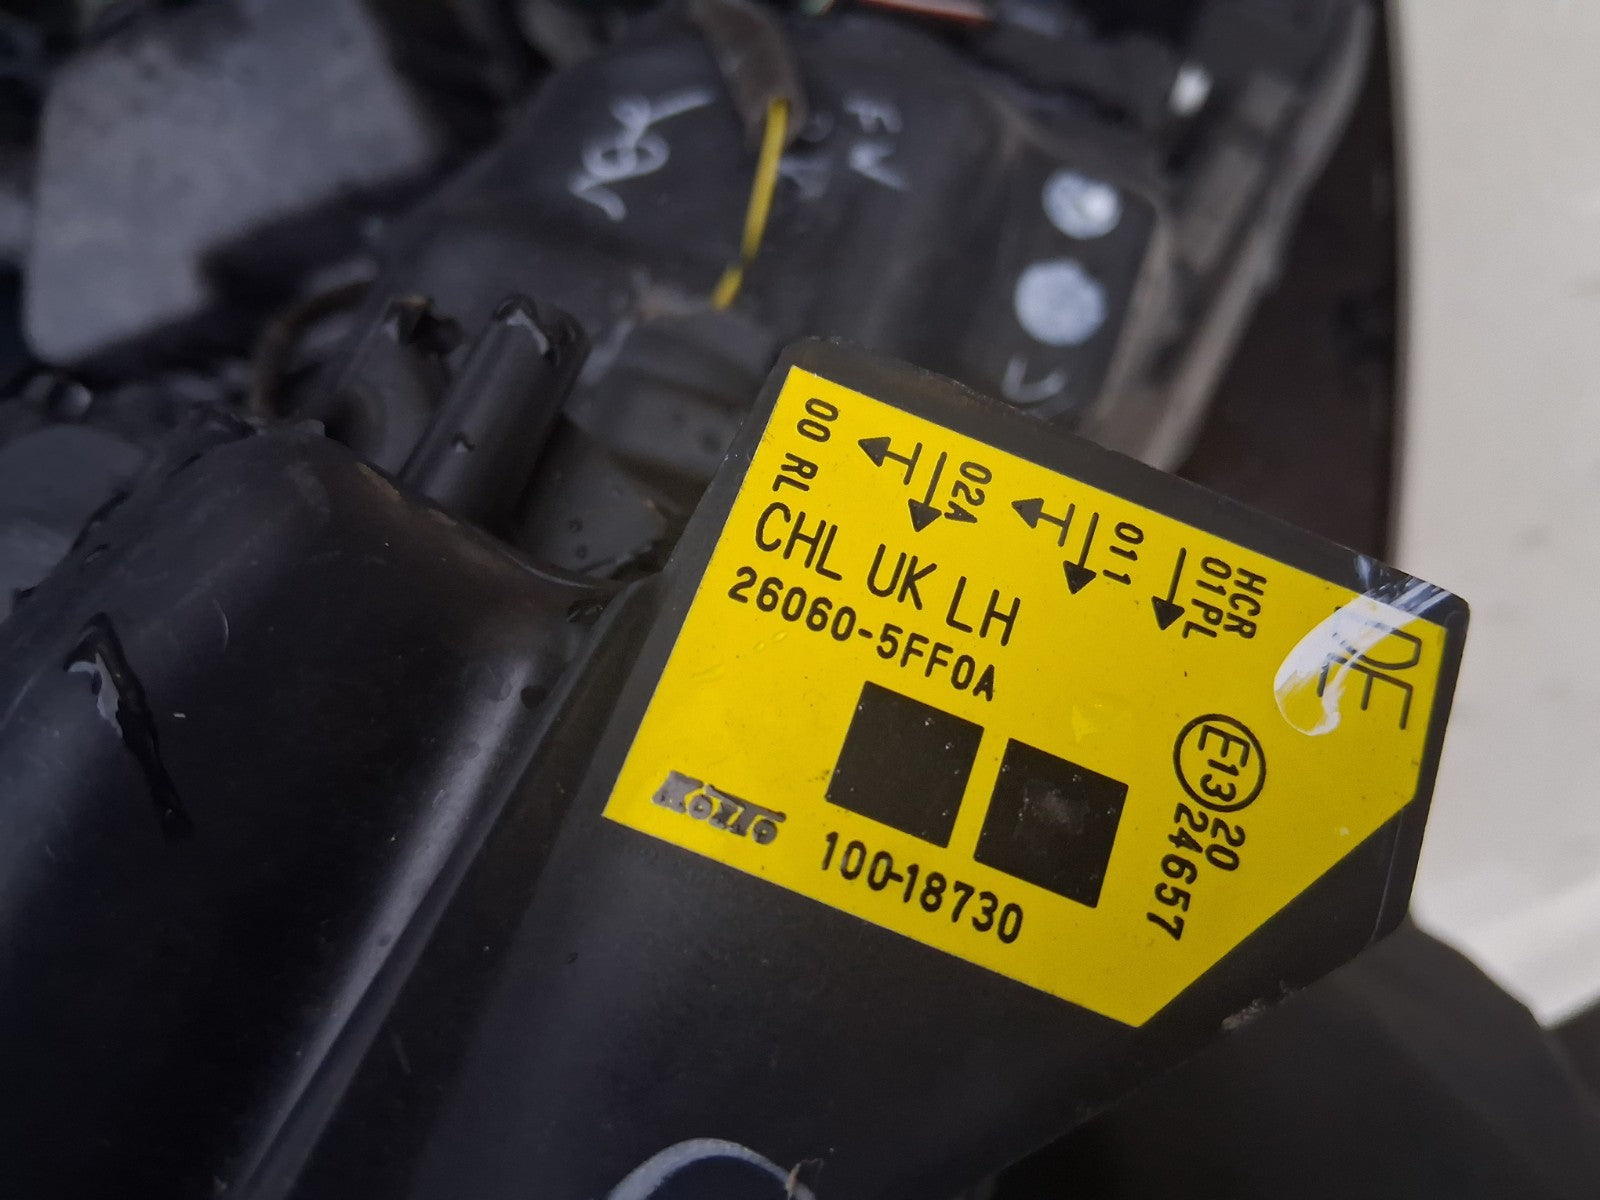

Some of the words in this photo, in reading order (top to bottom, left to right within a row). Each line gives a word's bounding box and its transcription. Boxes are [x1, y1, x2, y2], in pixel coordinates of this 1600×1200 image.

[797, 398, 838, 442] 00
[773, 453, 818, 491] RL
[944, 462, 992, 523] 02A
[756, 502, 842, 580] CHL
[867, 544, 937, 610] UK
[946, 576, 1020, 646] LH
[1223, 568, 1267, 639] HCR
[1198, 724, 1250, 802] E13
[1146, 803, 1209, 941] 24657
[1205, 818, 1246, 871] 20
[823, 832, 1023, 944] 100-18730
